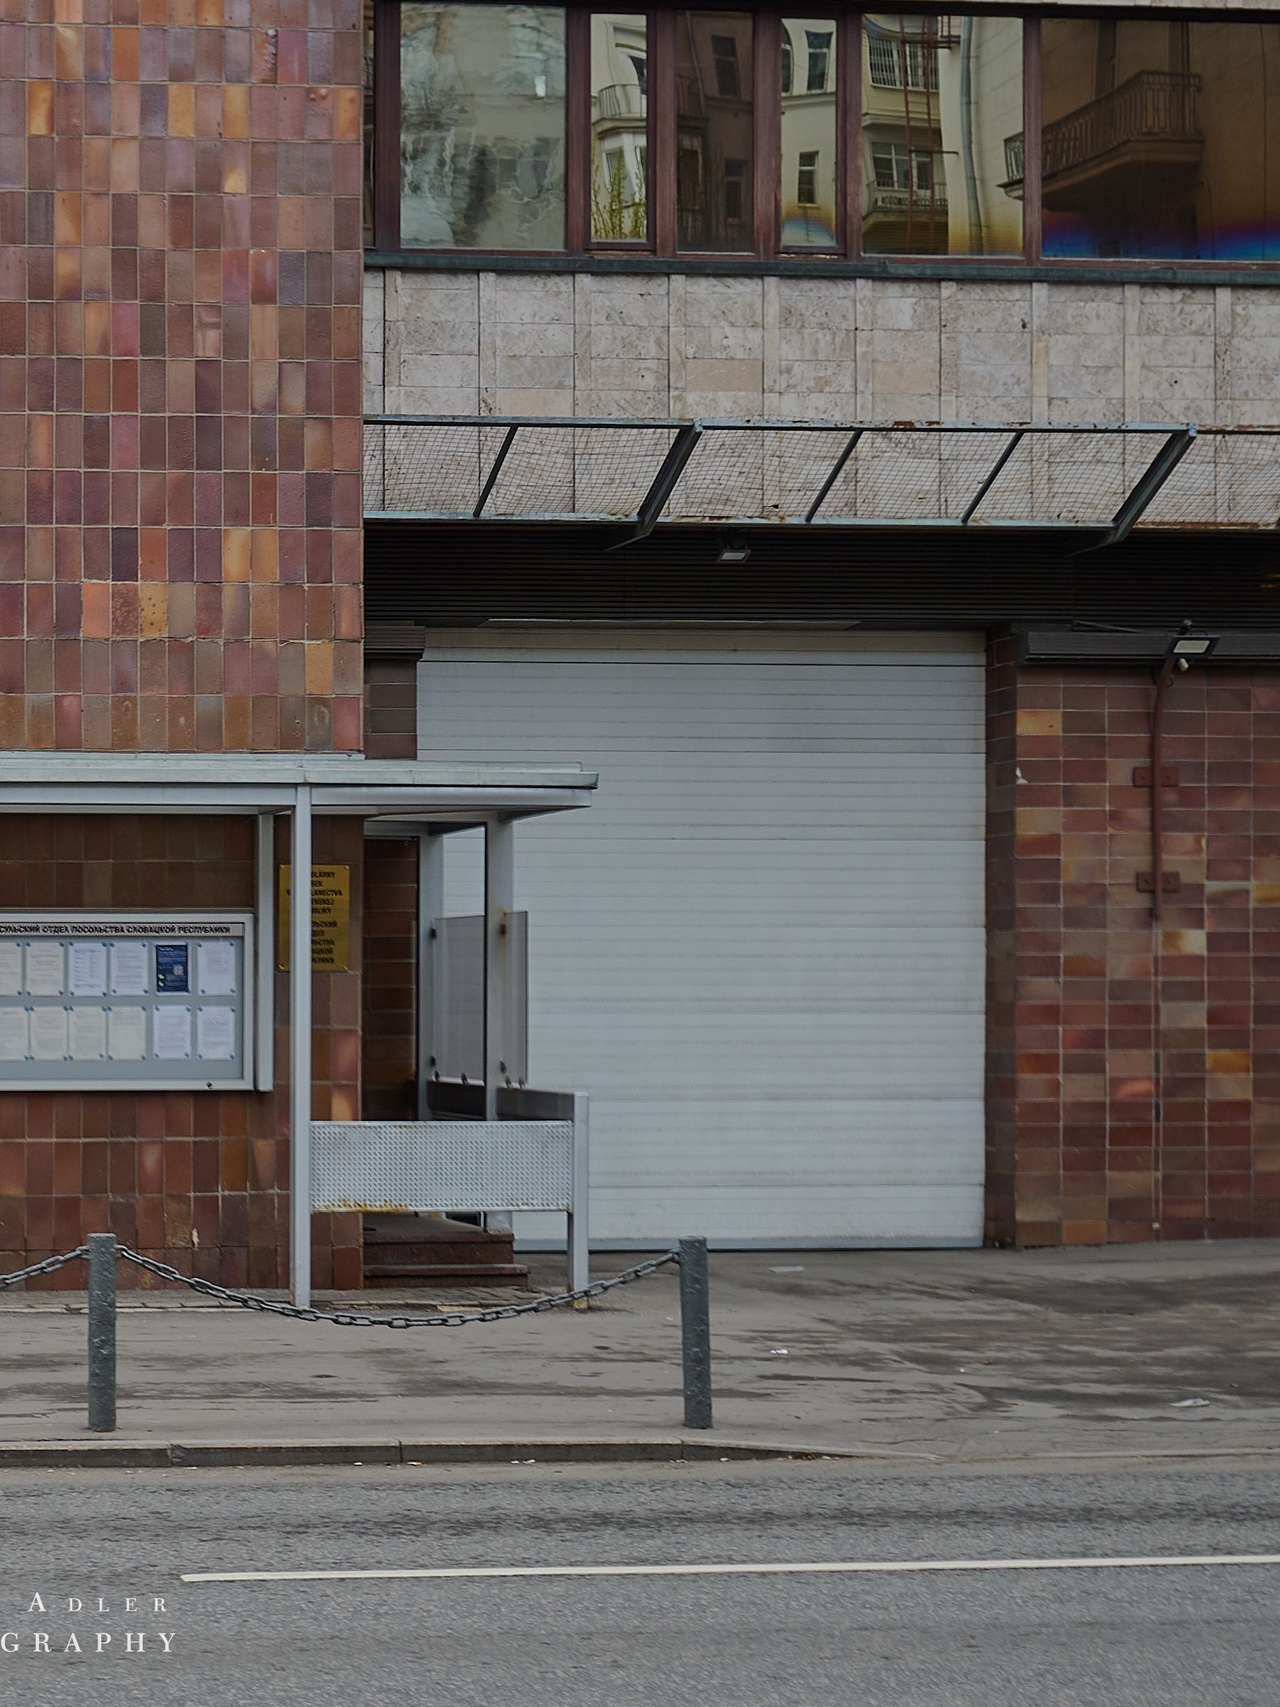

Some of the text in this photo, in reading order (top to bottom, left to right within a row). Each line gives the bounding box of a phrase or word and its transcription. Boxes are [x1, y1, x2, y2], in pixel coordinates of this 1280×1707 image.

[42, 925, 70, 934] ОТДЕЛ
[71, 925, 125, 933] ПОСОЛЬСТВА
[126, 925, 176, 935] СЛОВАЦКОЙ
[178, 926, 231, 934] РЕСПУБЛИКИ
